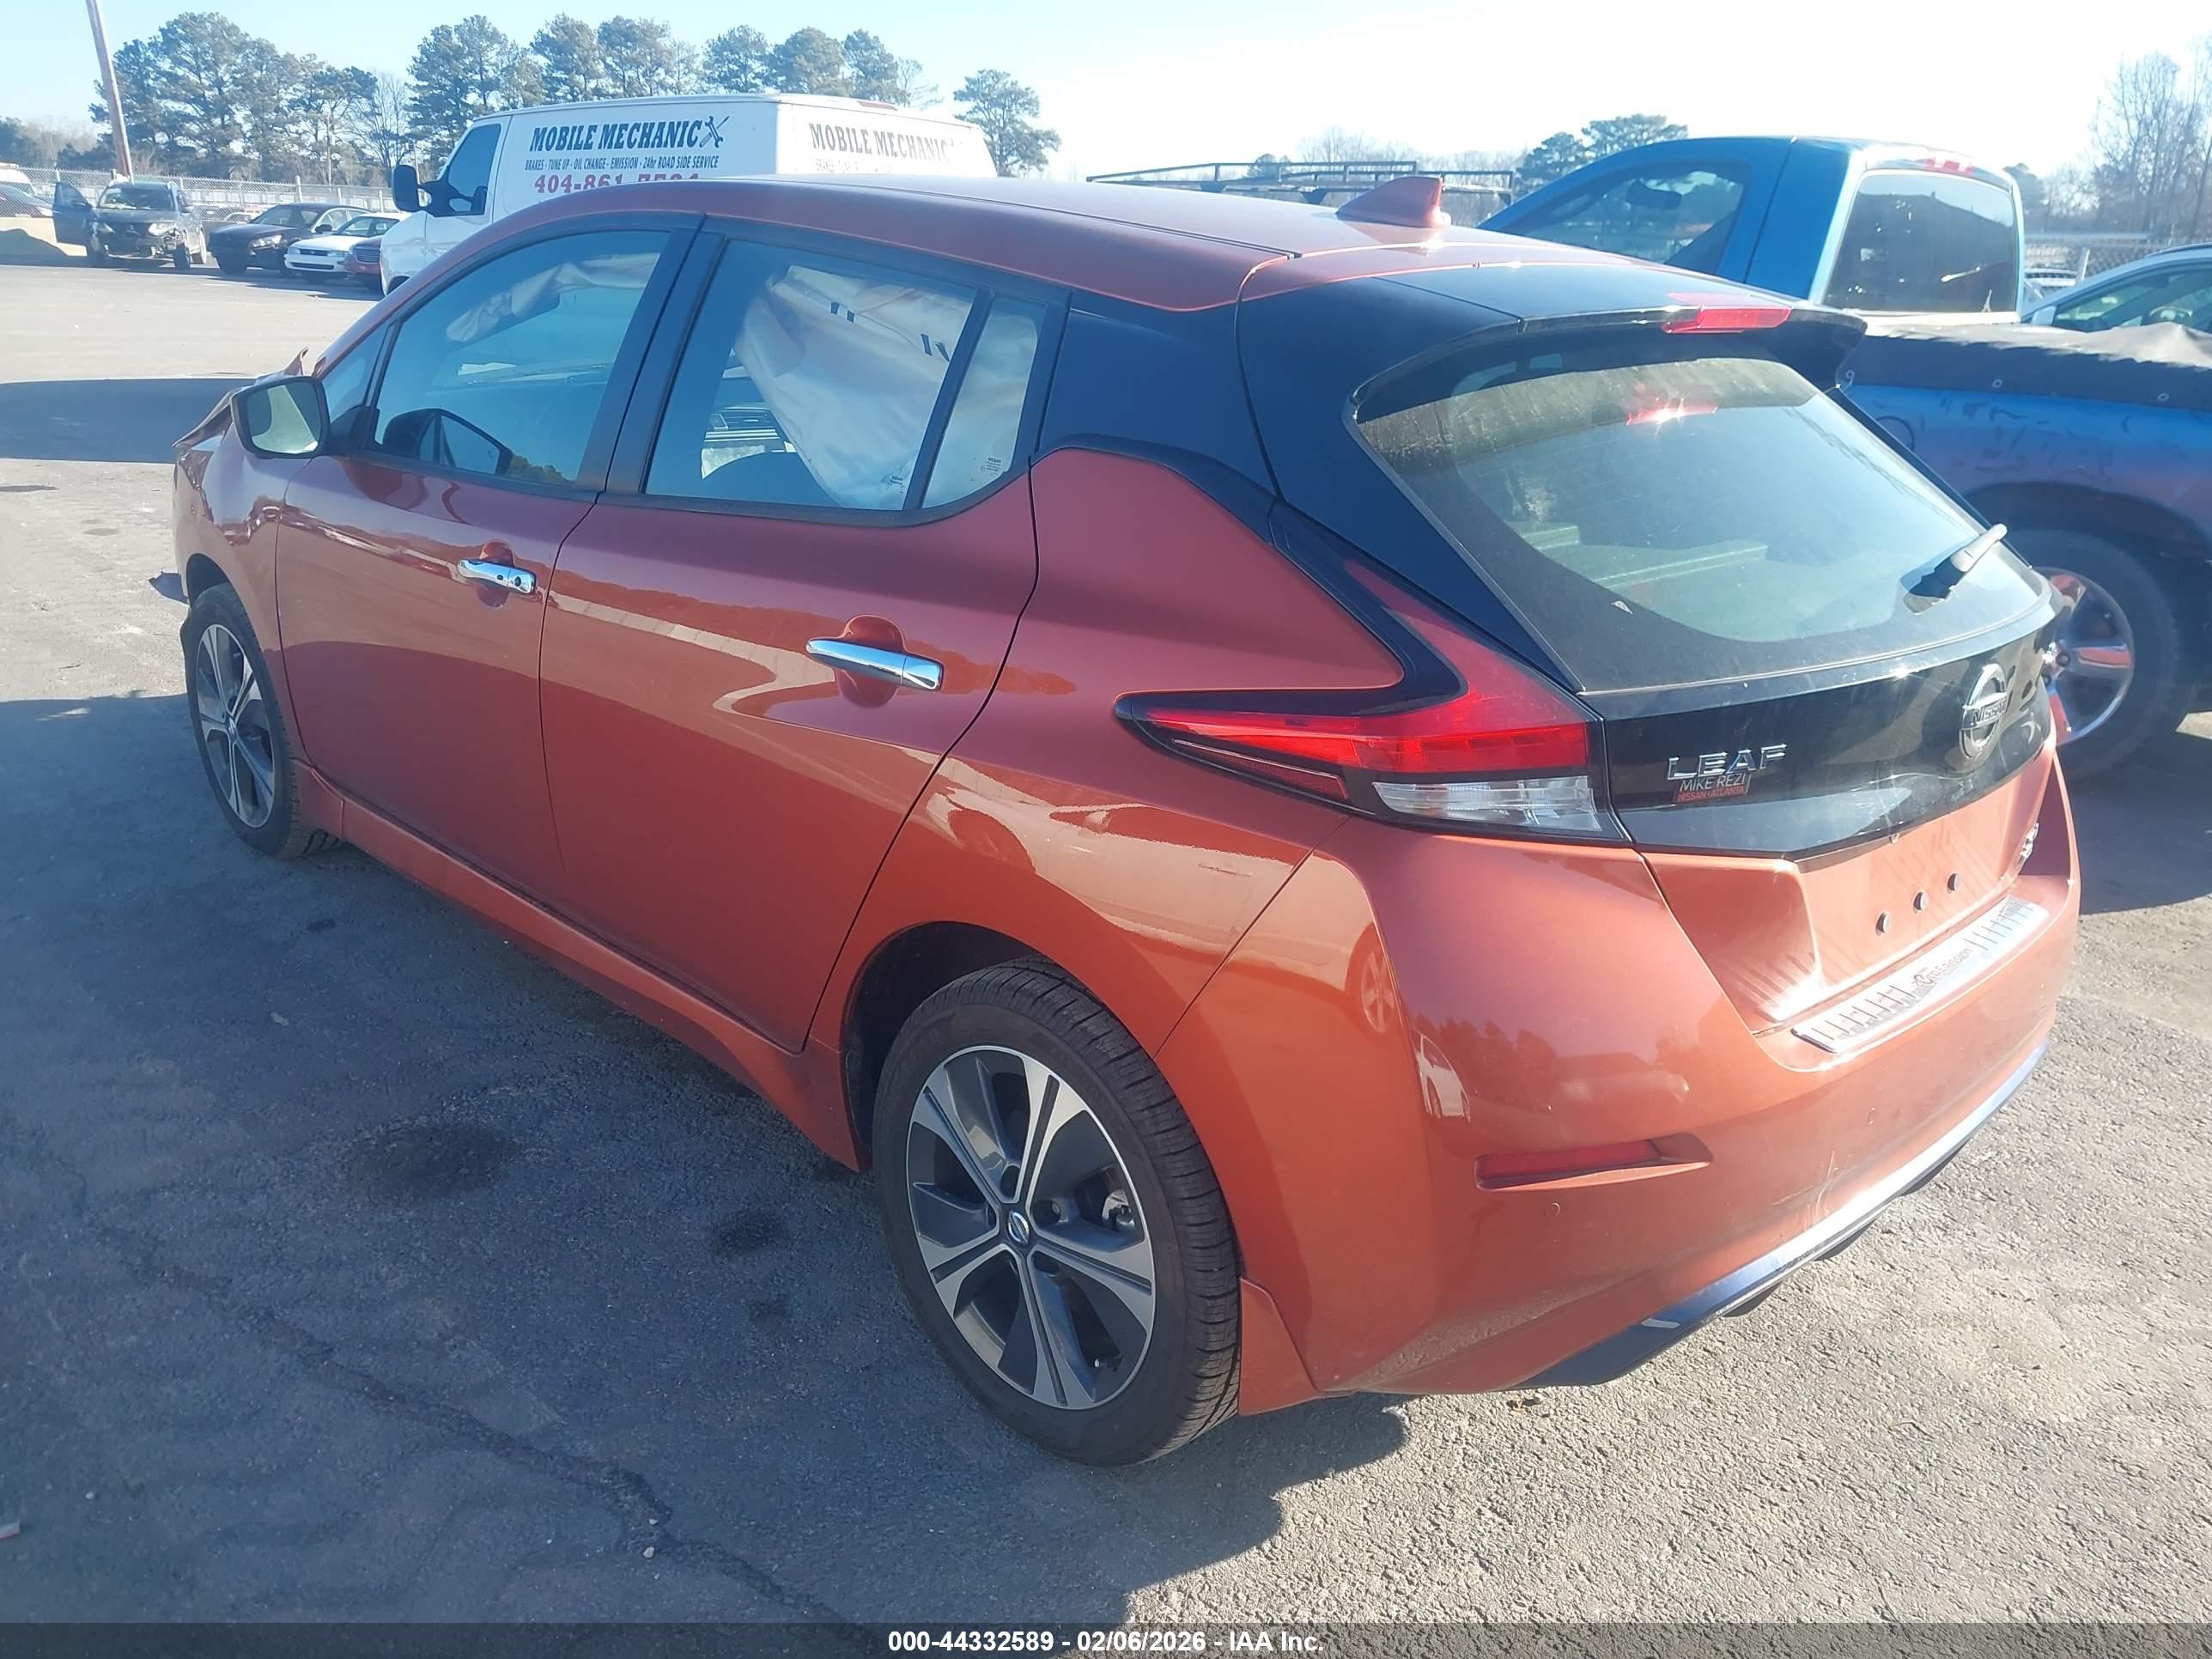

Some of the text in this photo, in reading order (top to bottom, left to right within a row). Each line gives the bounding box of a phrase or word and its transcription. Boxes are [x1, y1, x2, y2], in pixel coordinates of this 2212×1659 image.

[529, 119, 703, 152] MOBILE MECHANIC
[809, 123, 951, 163] MOBILE MECHANIC
[525, 159, 544, 171] BRAKES
[549, 159, 562, 170] TUNE
[562, 158, 570, 170] UP
[574, 158, 582, 170] OIL
[584, 157, 606, 170] CHANGE
[611, 156, 638, 169] EMISSION
[643, 155, 656, 169] 24hr
[658, 156, 675, 168] ROAD
[676, 155, 691, 168] SIDE
[692, 155, 719, 168] SERVICE
[1668, 744, 1787, 780] LEAF
[1680, 777, 1715, 792] MIKE
